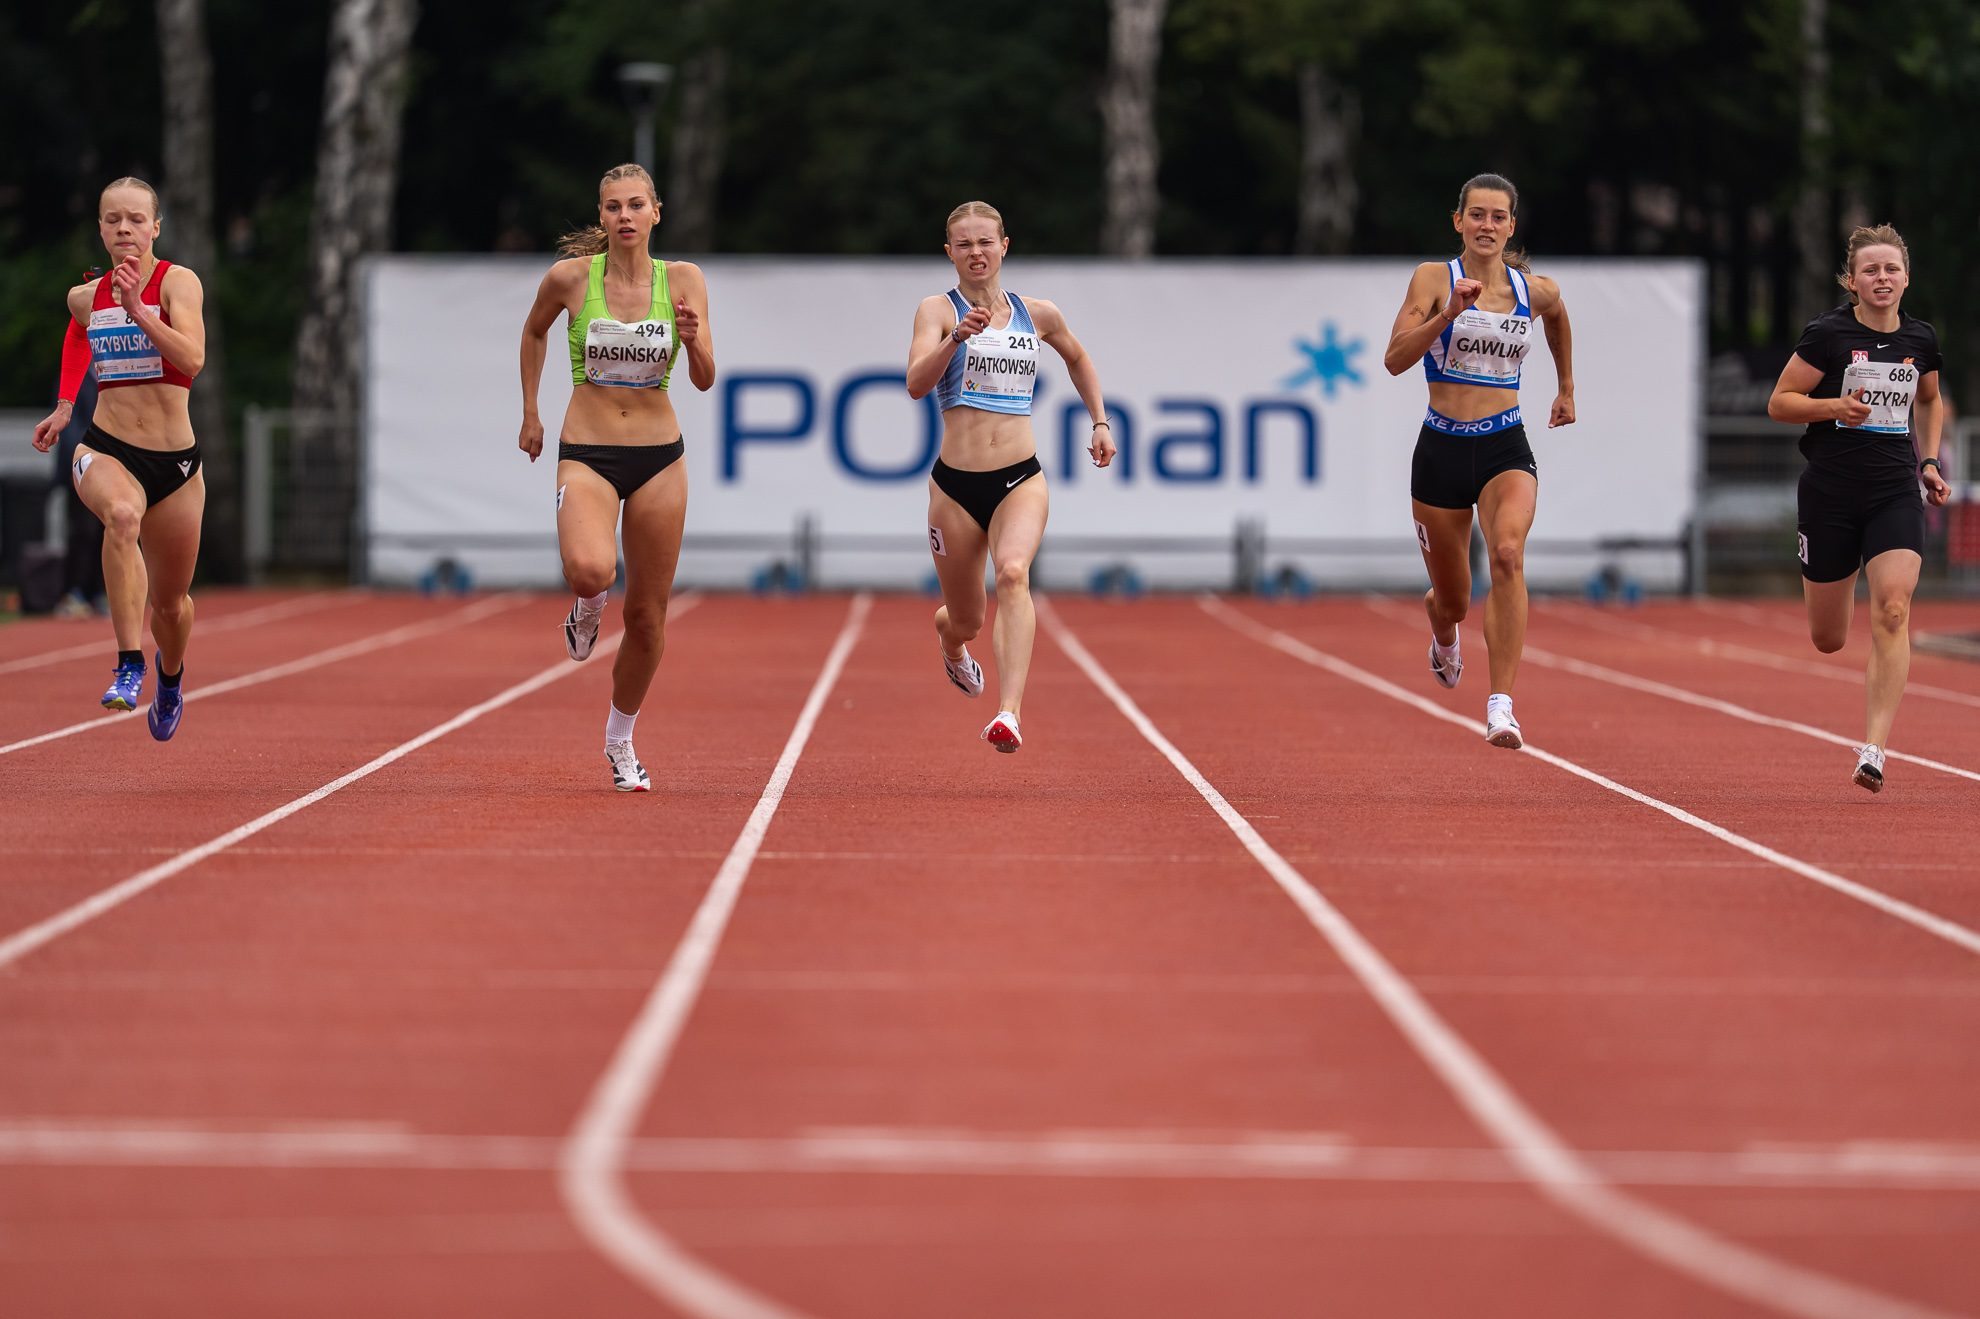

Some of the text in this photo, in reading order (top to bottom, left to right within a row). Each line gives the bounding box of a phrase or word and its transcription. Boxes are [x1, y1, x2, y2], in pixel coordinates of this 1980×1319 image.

[635, 324, 665, 337] 494
[1500, 318, 1527, 335] 475
[1008, 336, 1034, 350] 241
[1457, 337, 1524, 358] GAWLIK
[589, 344, 668, 363] BASIŃSKA
[967, 355, 1036, 376] PIĄTKOWSKA
[1888, 368, 1913, 382] 686
[718, 368, 1322, 486] POnan
[1426, 410, 1493, 433] IKE PRO
[74, 458, 83, 476] 7
[930, 527, 941, 552] 5
[1418, 524, 1427, 548] 4
